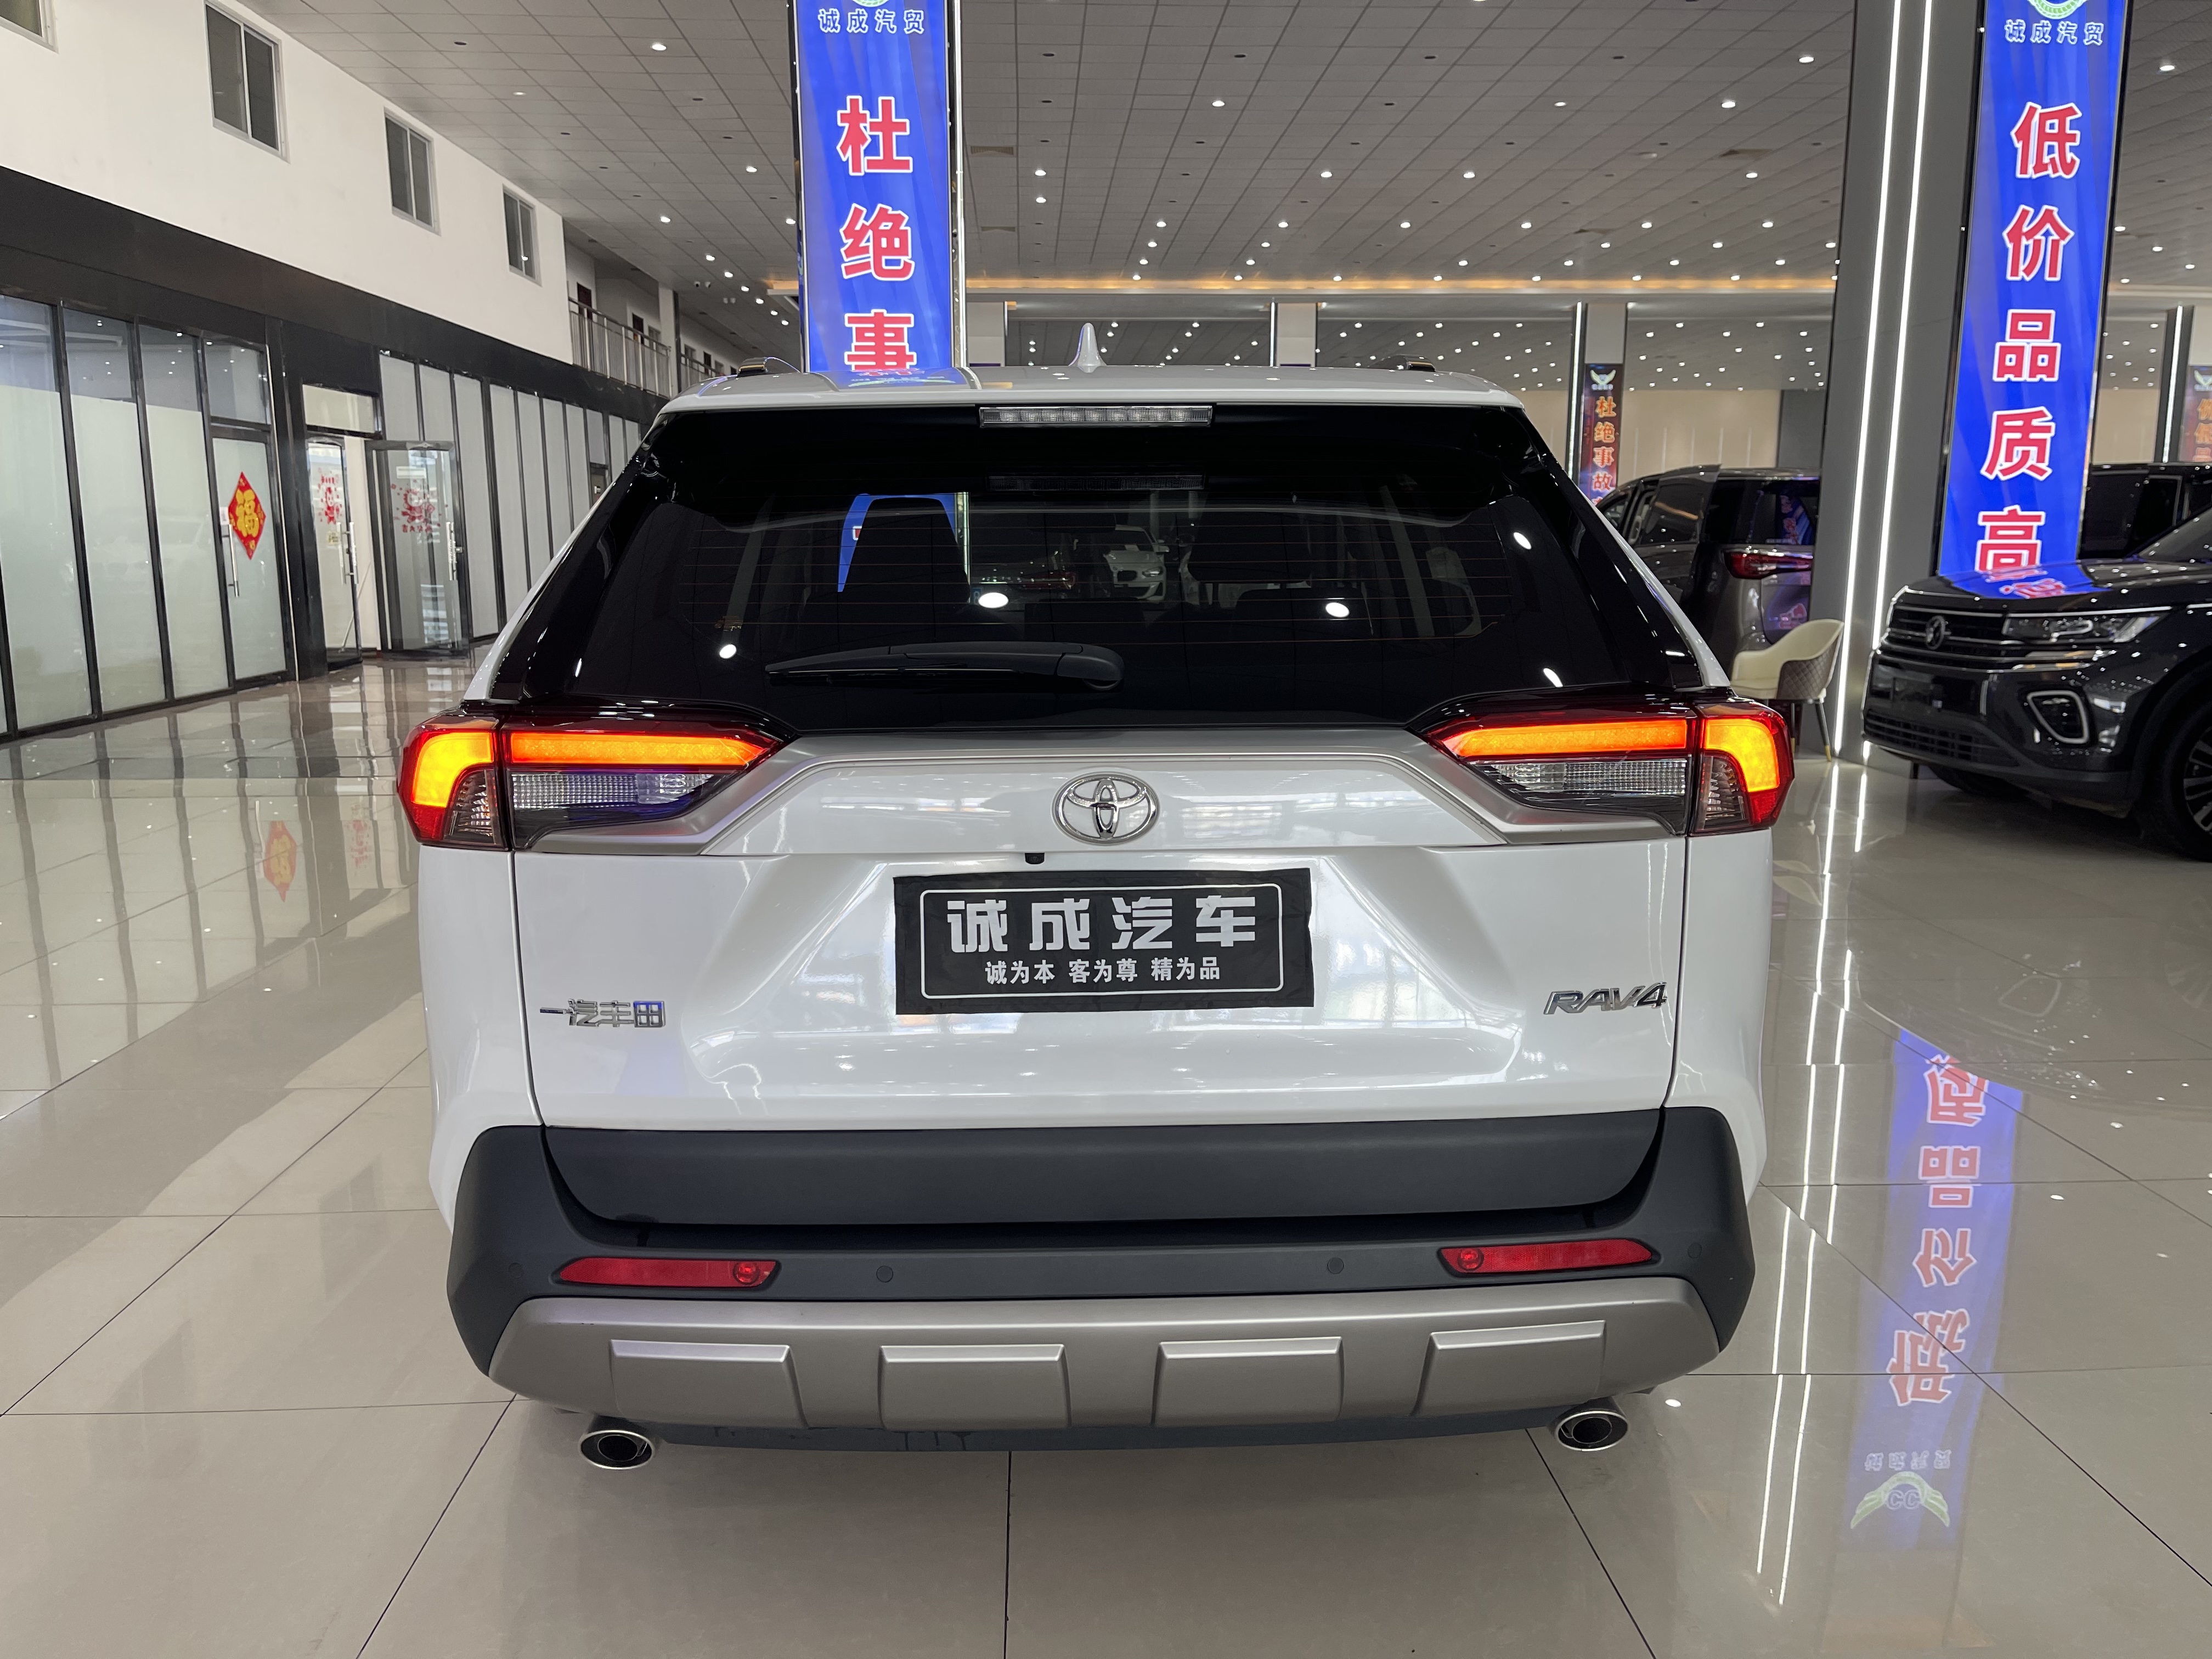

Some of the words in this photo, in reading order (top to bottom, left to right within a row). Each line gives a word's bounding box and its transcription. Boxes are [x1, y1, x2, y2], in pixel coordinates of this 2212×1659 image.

[817, 9, 925, 34] 诚成汽贸
[2004, 19, 2104, 46] 诚成汽贸
[836, 95, 917, 371] 杜绝事
[1974, 101, 2083, 572] 低价品质高
[235, 489, 259, 538] 福
[947, 894, 1256, 953] 诚成汽车
[985, 960, 1056, 985] 诚为本
[1068, 958, 1138, 983] 客为尊
[1151, 956, 1221, 981] 精为品
[539, 998, 665, 1028] 一汽丰田
[1543, 981, 1668, 1015] RAV4
